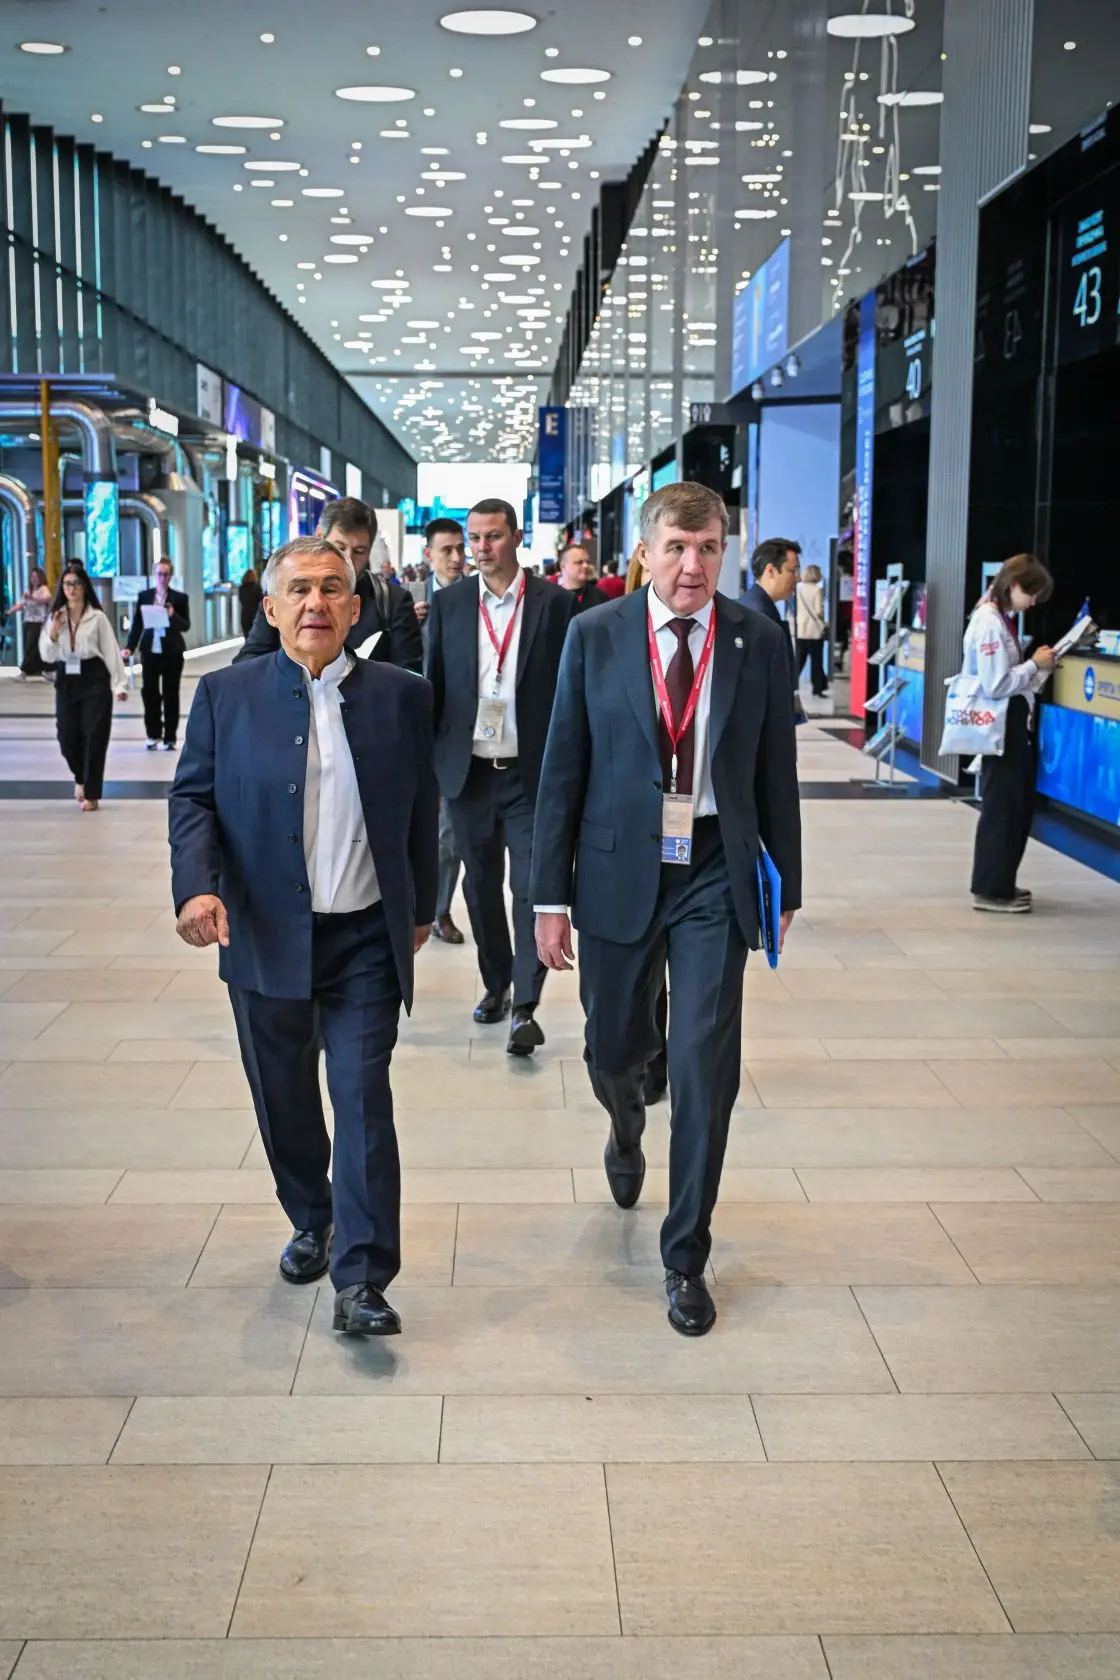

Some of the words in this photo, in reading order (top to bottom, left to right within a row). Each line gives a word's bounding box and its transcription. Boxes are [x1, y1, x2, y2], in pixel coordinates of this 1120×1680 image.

[1073, 265, 1102, 327] 43
[906, 358, 922, 400] 40
[545, 412, 559, 436] E
